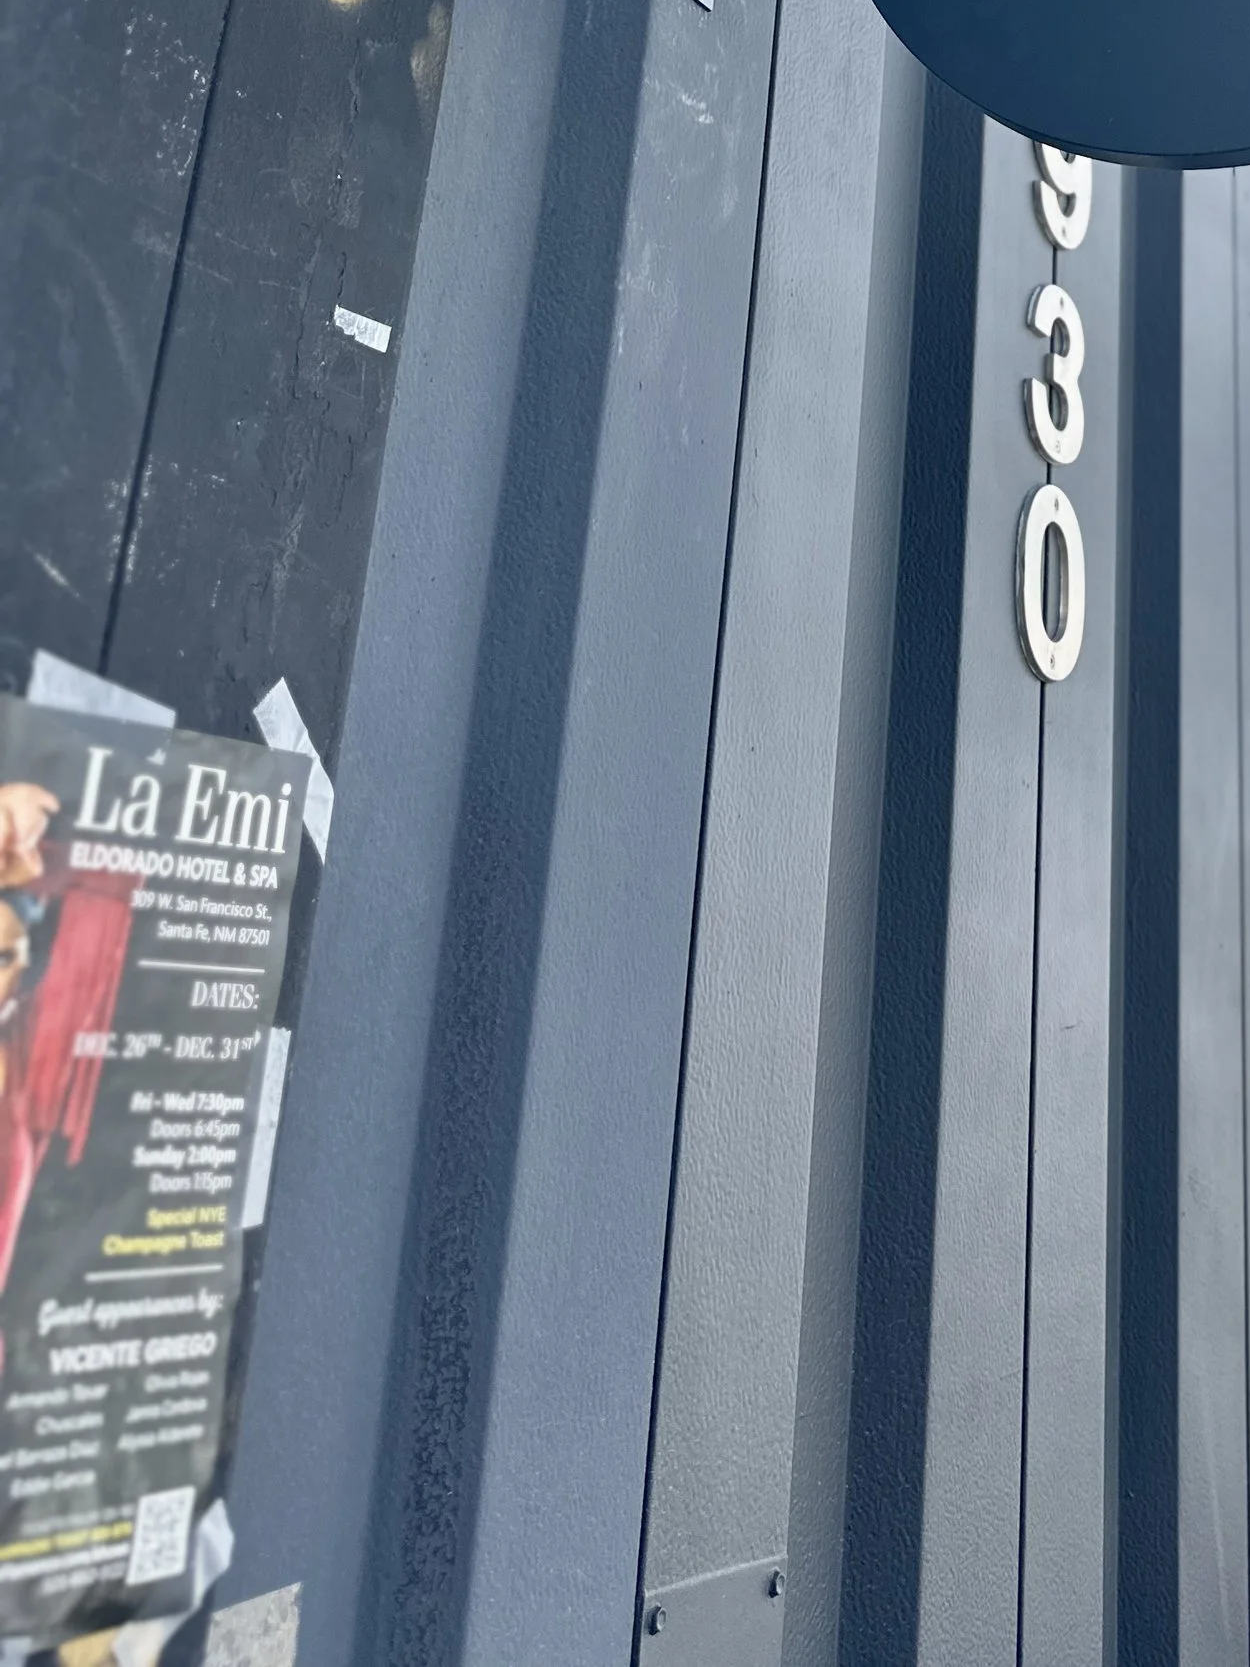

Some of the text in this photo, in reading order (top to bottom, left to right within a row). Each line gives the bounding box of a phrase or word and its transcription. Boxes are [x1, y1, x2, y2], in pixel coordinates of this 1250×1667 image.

[174, 763, 292, 854] Emi
[69, 840, 279, 890] ELDORADO HOTEL & SPA
[176, 895, 198, 913] San
[200, 897, 254, 919] Francisco
[156, 920, 193, 940] Santa
[213, 925, 236, 944] NM
[238, 928, 271, 947] 87501
[189, 979, 261, 1011] DATES:
[173, 1035, 216, 1061] DEC.
[163, 1091, 196, 1113] Wed
[196, 1092, 246, 1117] 7:30pm
[149, 1117, 241, 1143] Doors 6:45pm
[132, 1144, 237, 1171] Sunday 2:00pm
[148, 1170, 191, 1195] Doors
[146, 1204, 228, 1231] Special NYE
[189, 1230, 226, 1251] Toast
[49, 1331, 218, 1376] VICENTE GRIEGO
